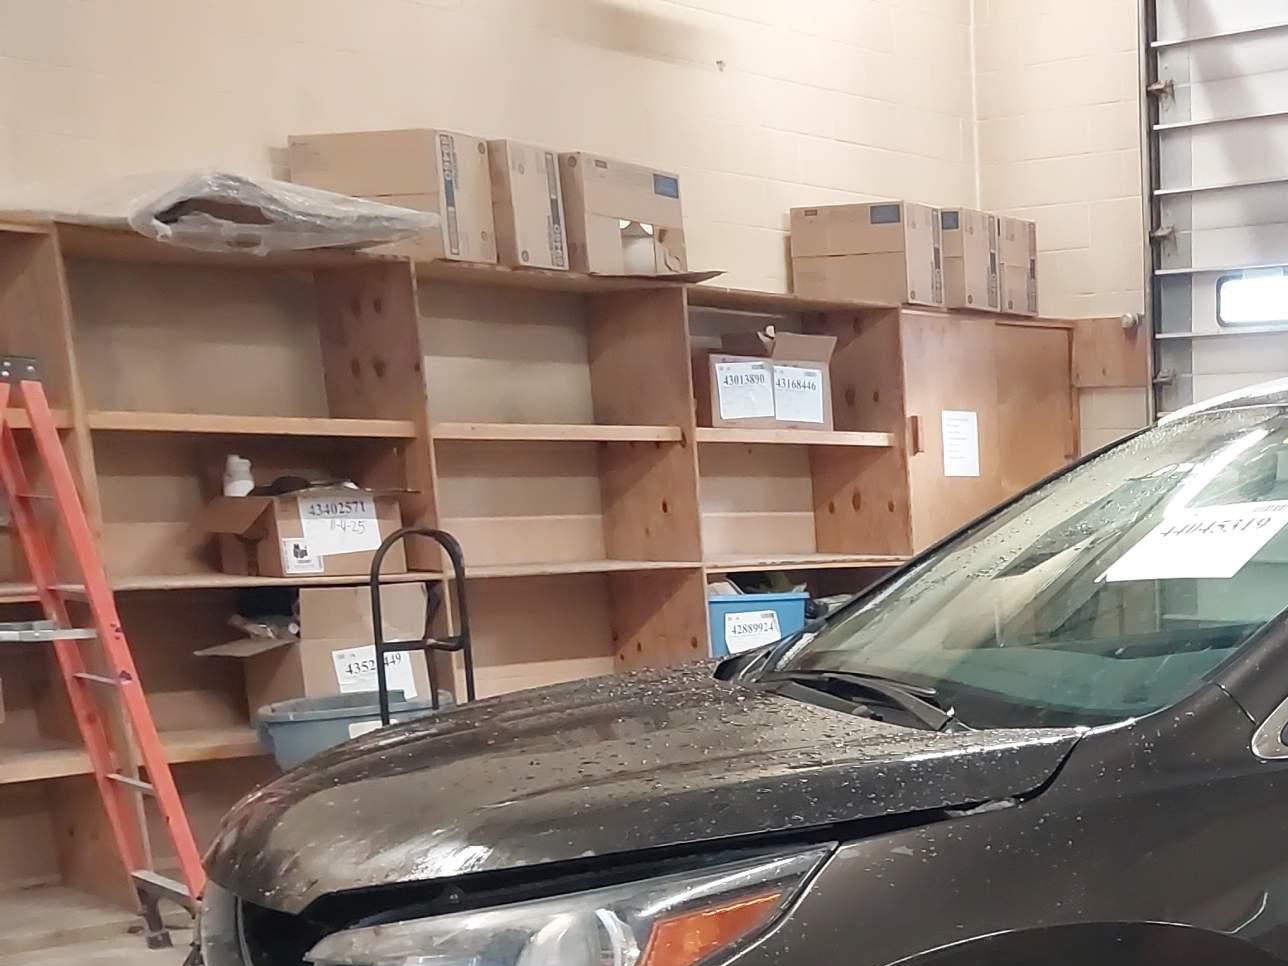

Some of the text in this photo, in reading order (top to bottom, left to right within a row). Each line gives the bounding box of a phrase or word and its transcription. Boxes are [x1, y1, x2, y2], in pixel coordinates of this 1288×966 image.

[722, 373, 766, 386] 43013890
[775, 378, 817, 391] 43168446
[308, 501, 366, 516] 43402571
[731, 622, 774, 635] 42889924
[345, 653, 402, 675] 4352449
